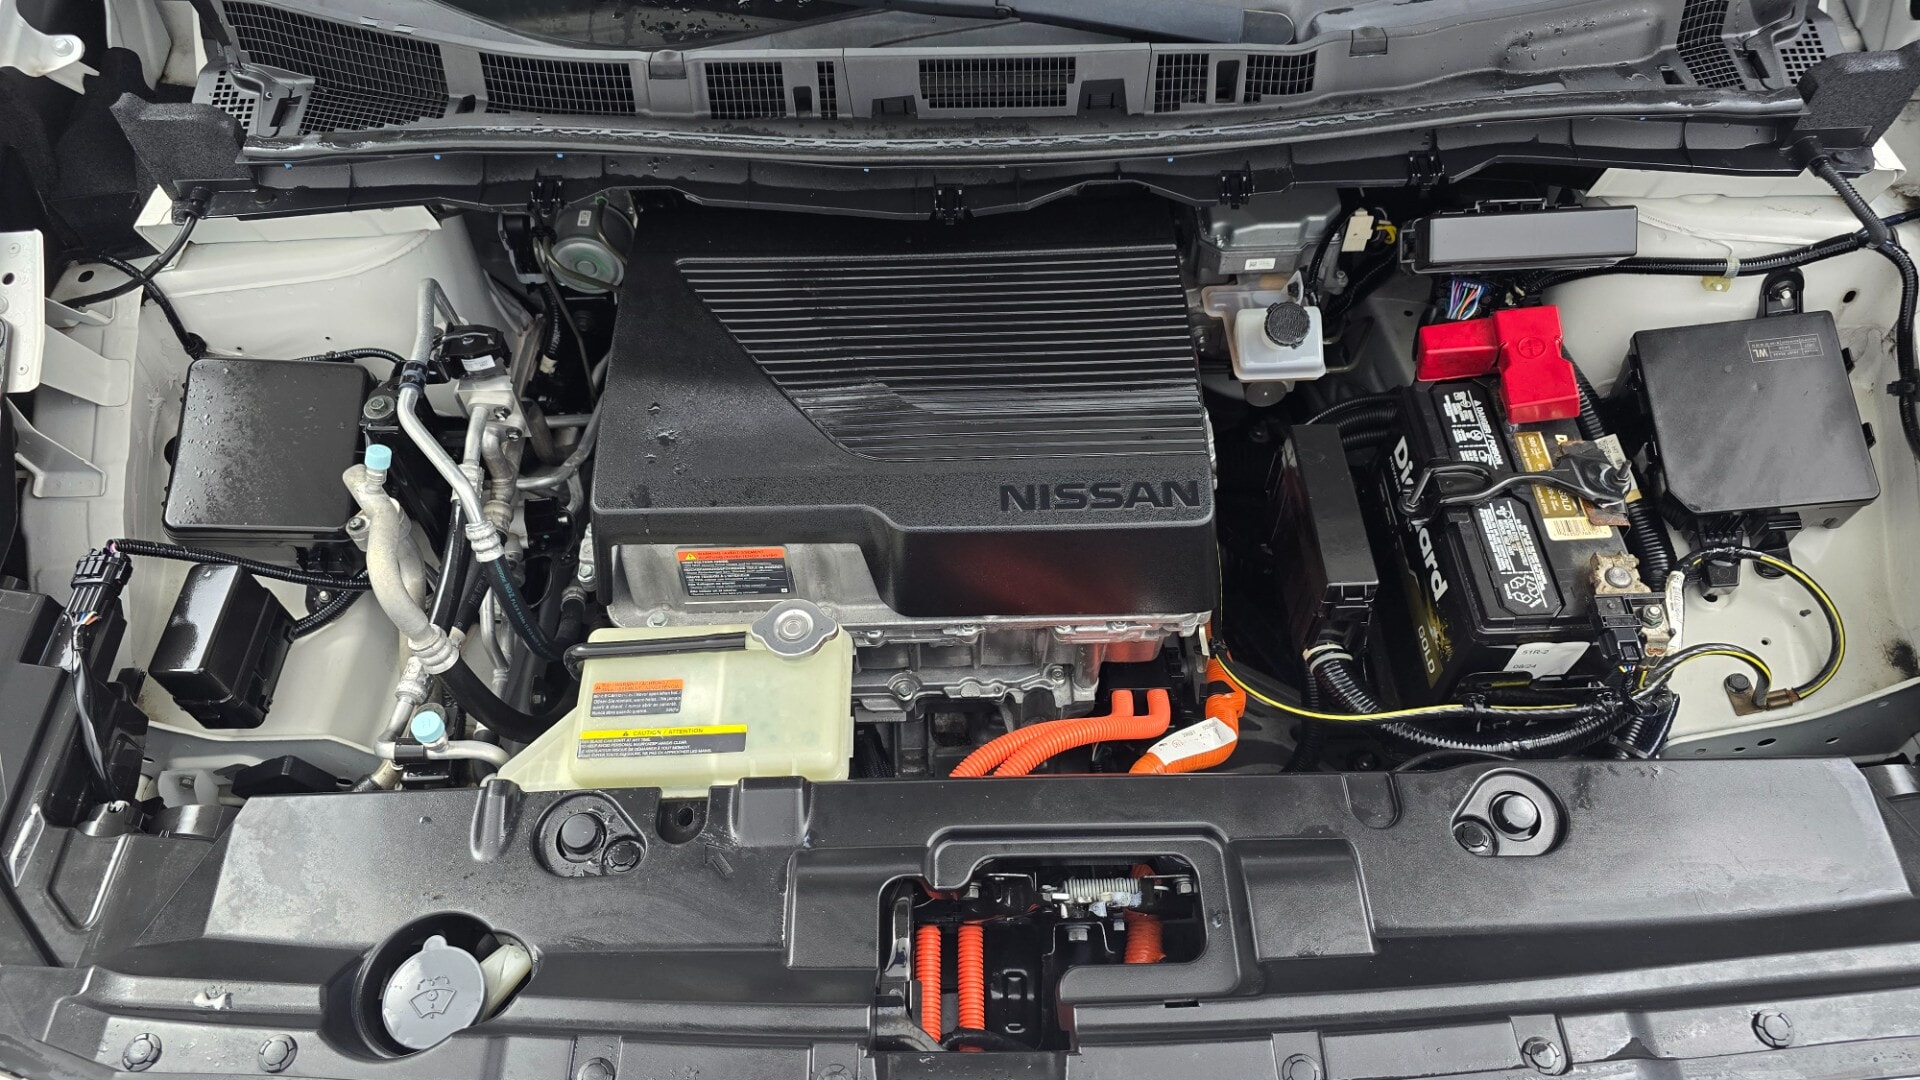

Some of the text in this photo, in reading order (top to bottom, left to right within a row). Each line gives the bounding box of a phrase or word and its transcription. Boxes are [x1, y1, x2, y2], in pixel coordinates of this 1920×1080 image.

[1476, 405, 1491, 433] DANGER
[1488, 439, 1503, 465] POISON
[1000, 480, 1200, 512] NISSAN
[1394, 436, 1448, 602] Diard
[1418, 625, 1436, 674] GOLD
